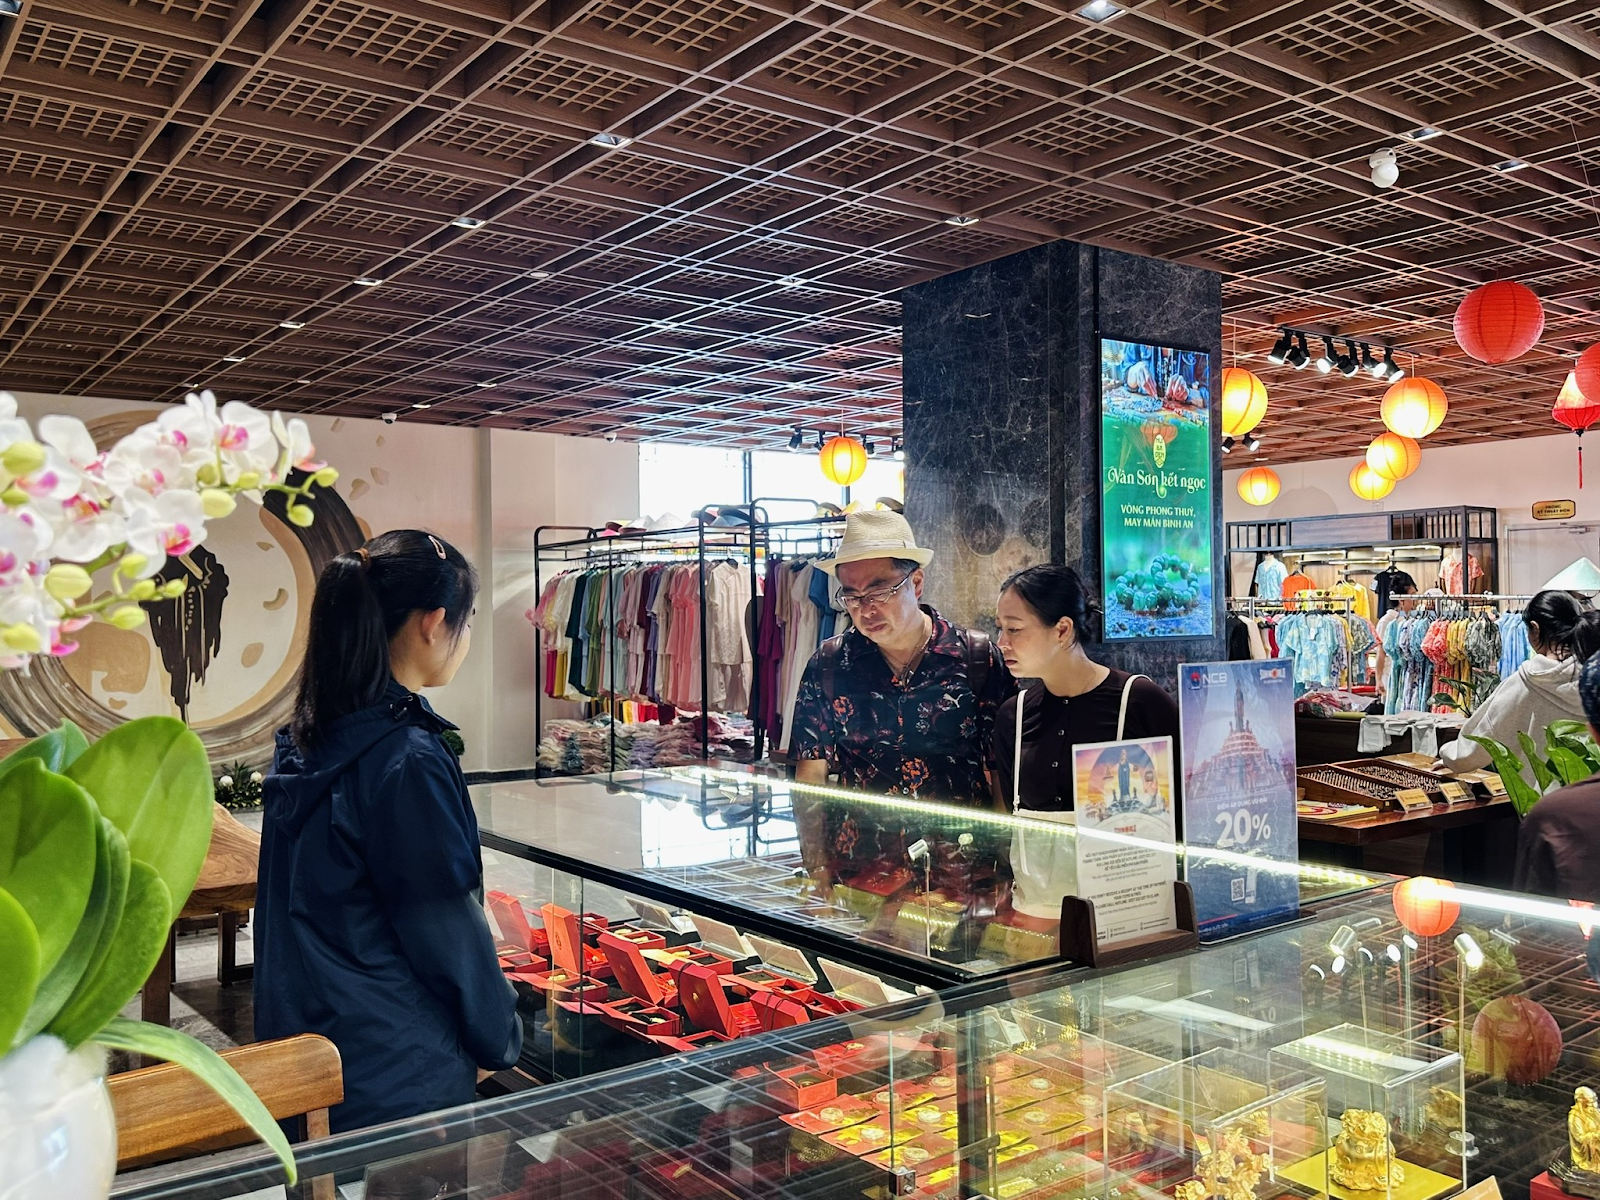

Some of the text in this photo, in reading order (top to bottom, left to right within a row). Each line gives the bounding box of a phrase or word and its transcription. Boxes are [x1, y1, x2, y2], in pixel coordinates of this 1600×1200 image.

[1181, 477, 1206, 493] ngọc
[1121, 503, 1144, 515] VÒNG
[1145, 506, 1173, 516] PHONG
[1124, 518, 1142, 527] MAY
[1163, 517, 1181, 528] BÌNH
[1182, 520, 1194, 529] AN
[1202, 672, 1227, 685] NCB
[1215, 808, 1271, 848] 20%
